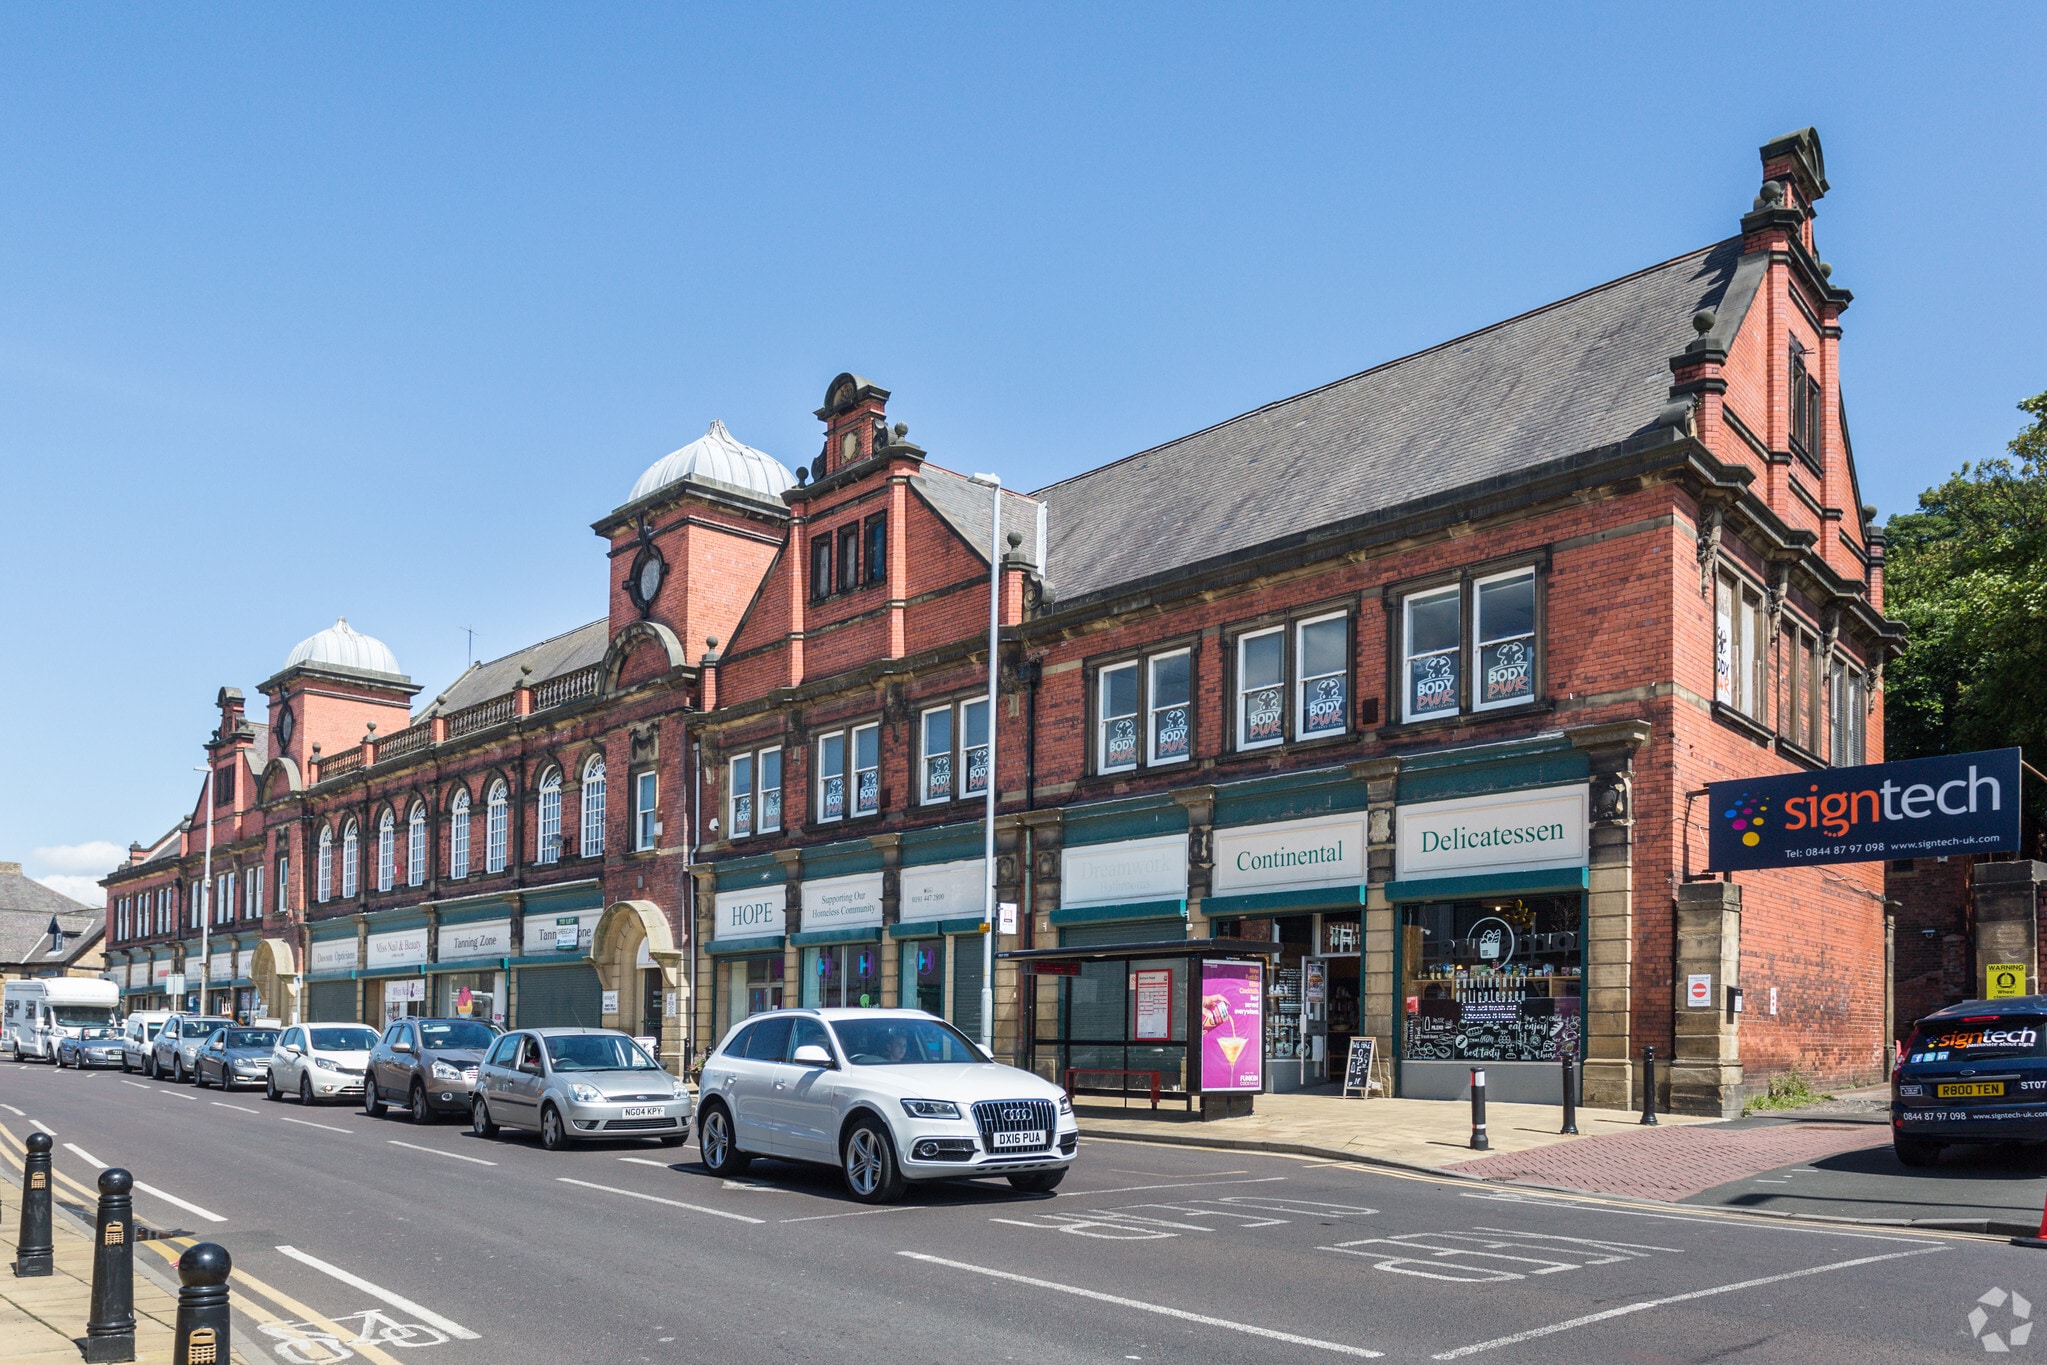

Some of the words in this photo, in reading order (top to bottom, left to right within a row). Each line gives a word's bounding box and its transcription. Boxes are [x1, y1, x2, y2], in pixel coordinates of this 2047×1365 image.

[1488, 666, 1528, 684] BODY
[1418, 679, 1454, 696] BODY
[1488, 676, 1528, 699] PWR
[1417, 690, 1455, 710] PWR
[1309, 701, 1342, 716] BODY
[1251, 711, 1281, 726] BODY
[1309, 710, 1343, 729] PWR
[1160, 730, 1187, 743] BODY
[1250, 720, 1282, 739] PWR
[1110, 740, 1135, 752] BODY
[1159, 738, 1188, 755] PWR
[1109, 747, 1136, 764] PWR
[931, 774, 950, 787] BODY
[860, 786, 878, 798] BODY
[930, 781, 950, 797] PWR
[1784, 765, 2000, 838] signtech
[1421, 823, 1564, 853] Delicatessen
[1785, 849, 1803, 858] Tel:
[1805, 847, 1831, 857] 0844
[1833, 845, 1847, 855] 87
[1849, 844, 1863, 854] 97
[1865, 842, 1885, 852] 098
[1891, 834, 2000, 850] www.signtech-uk.com
[1237, 840, 1343, 871] Continental
[821, 893, 853, 906] Supporting
[853, 891, 866, 900] Our
[731, 902, 773, 926] HOPE
[811, 906, 840, 919] Homeless
[840, 903, 876, 916] Community
[539, 929, 557, 941] Tann
[578, 928, 592, 938] one
[404, 939, 421, 952] Beauty
[454, 936, 479, 951] Tanning
[479, 935, 497, 947] Zone
[1456, 975, 1526, 989] continental
[1456, 989, 1526, 1003] delicatessen
[1508, 1020, 1522, 1032] eat
[1524, 1021, 1547, 1035] enjoy
[1938, 1026, 2037, 1049] signtech
[1464, 1047, 1479, 1058] best
[1479, 1047, 1500, 1060] tasty
[1943, 1085, 1973, 1096] R800
[1976, 1084, 1999, 1095] TEN
[2021, 1080, 2046, 1089] ST07
[624, 1108, 646, 1116] NG04
[647, 1107, 662, 1115] KPY
[1924, 1112, 1934, 1120] 87
[1936, 1112, 1947, 1120] 97
[1950, 1112, 1967, 1120] 098
[999, 1133, 1021, 1145] DX16
[1023, 1132, 1041, 1143] PUA
